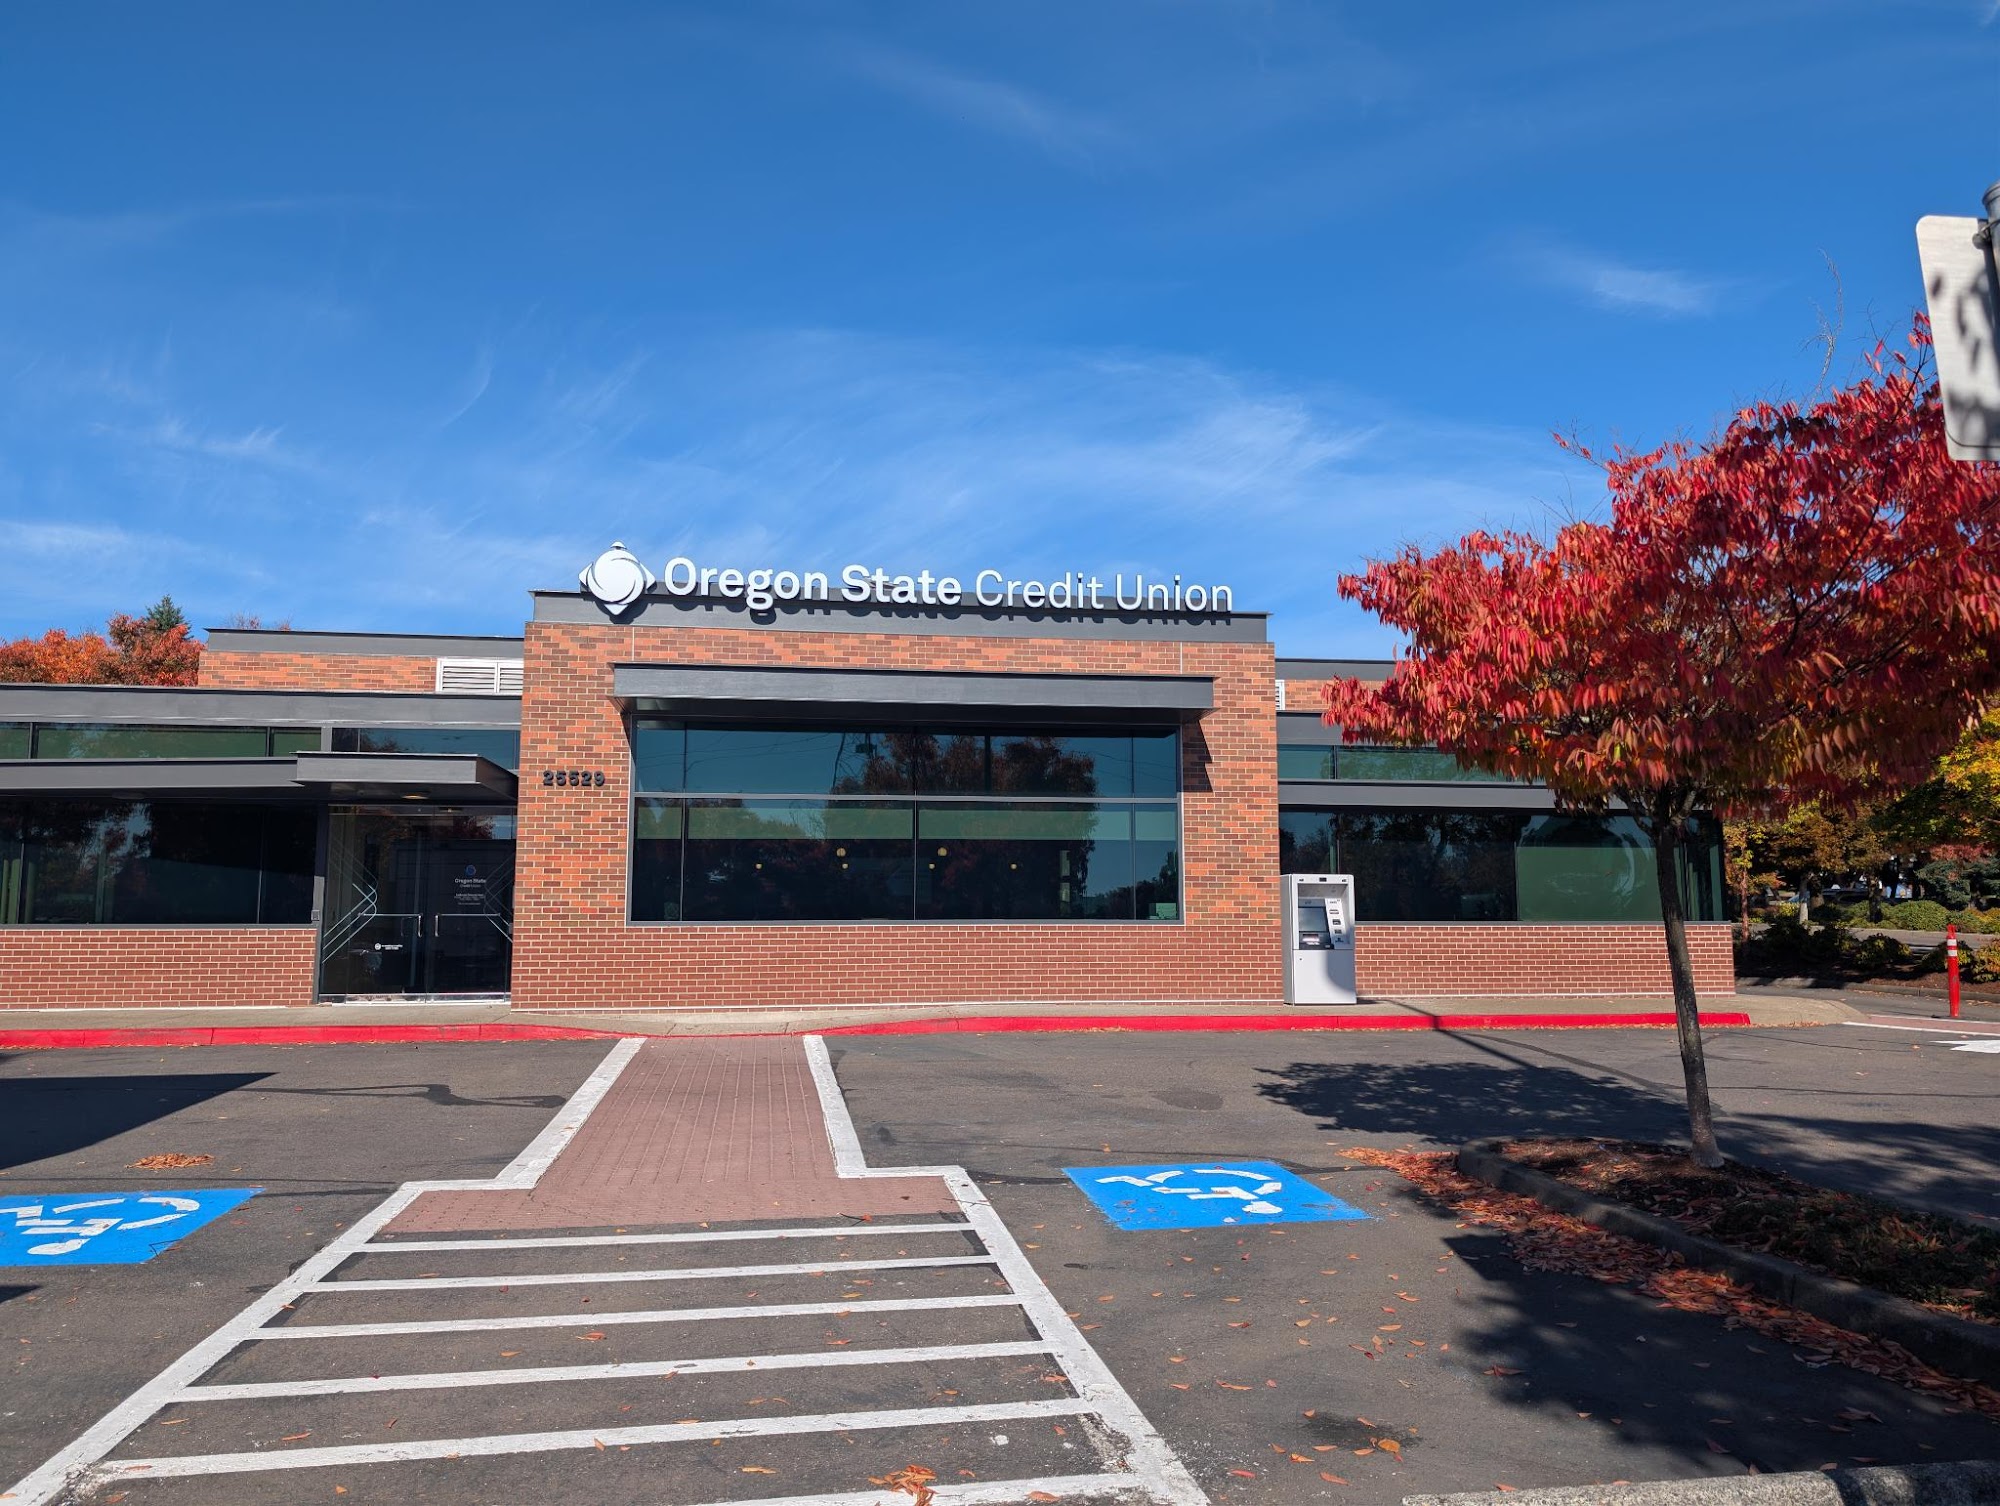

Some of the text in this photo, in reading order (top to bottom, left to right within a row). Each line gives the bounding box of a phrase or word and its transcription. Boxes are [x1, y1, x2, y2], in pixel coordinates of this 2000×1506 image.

[664, 557, 1232, 611] Oregon State Credit Union
[543, 770, 605, 787] 25529
